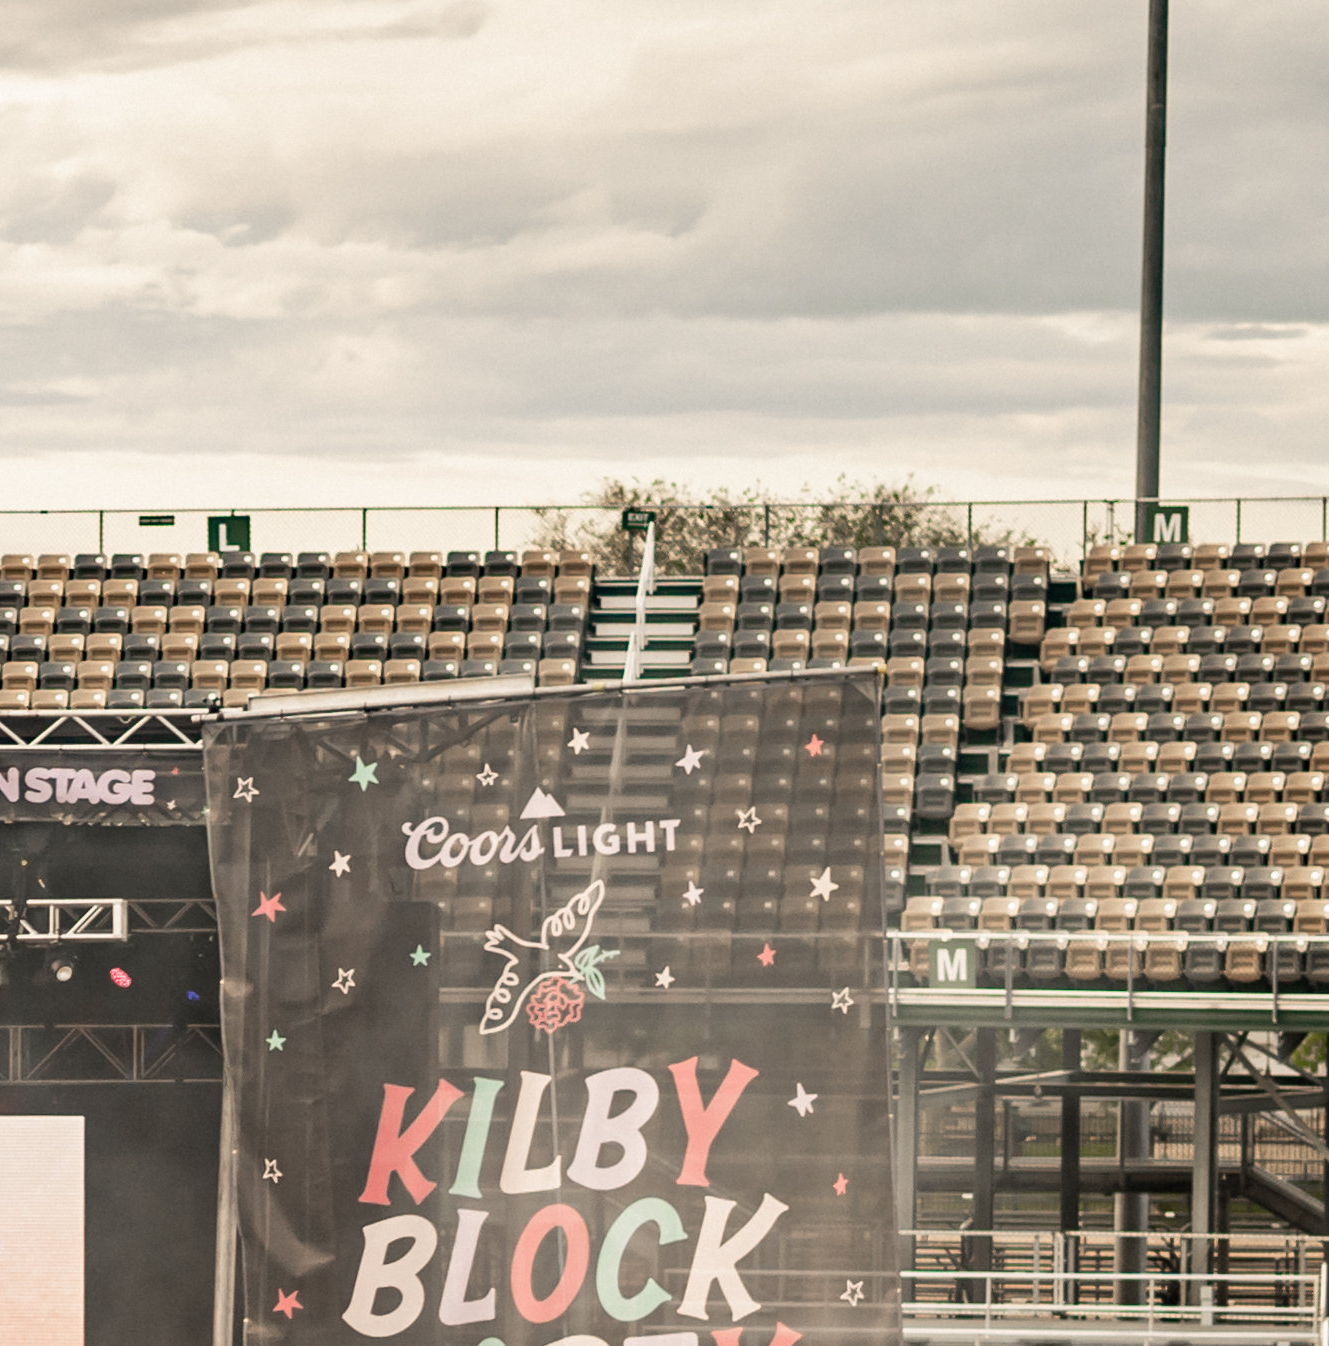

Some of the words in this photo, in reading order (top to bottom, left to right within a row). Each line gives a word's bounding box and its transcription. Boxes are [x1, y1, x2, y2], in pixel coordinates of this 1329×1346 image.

[218, 523, 240, 552] L
[1153, 513, 1182, 543] M
[25, 767, 157, 805] STAGE
[401, 815, 545, 871] Coors
[552, 818, 682, 859] LIGHT
[936, 948, 968, 982] M
[356, 1055, 760, 1206] KILBY
[341, 1192, 790, 1338] BLOCK
